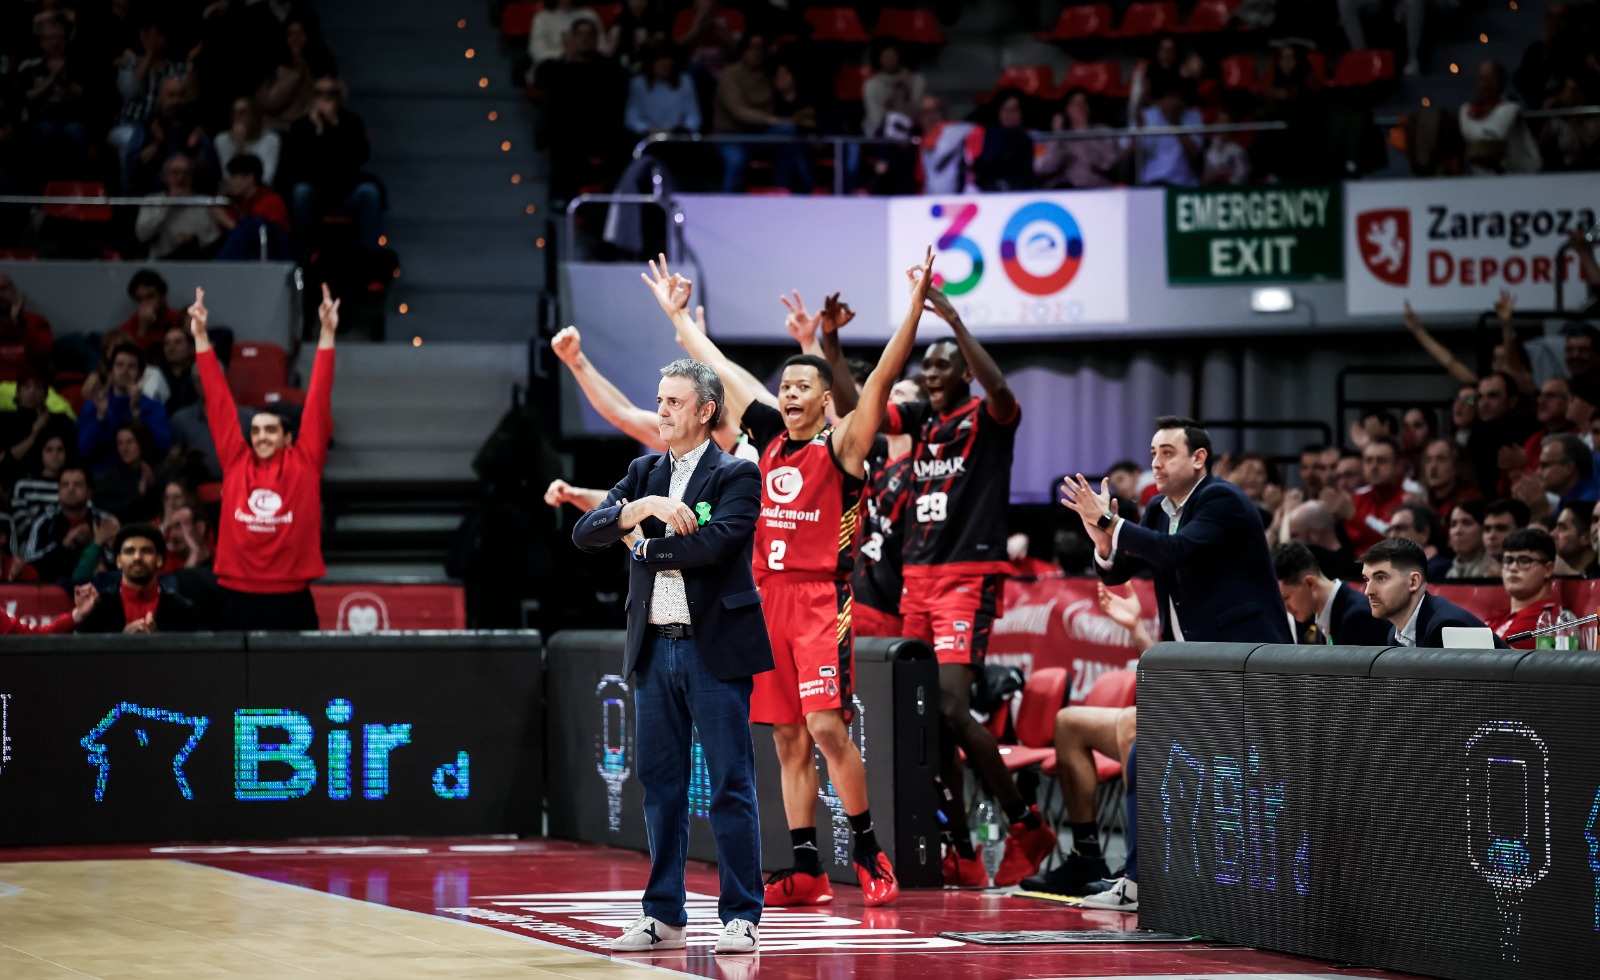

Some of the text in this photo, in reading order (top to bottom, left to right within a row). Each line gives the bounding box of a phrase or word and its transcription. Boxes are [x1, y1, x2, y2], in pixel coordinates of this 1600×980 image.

[1175, 189, 1330, 232] EMERGENCY
[1427, 204, 1597, 249] Zaragoza
[930, 201, 1084, 297] 30
[1210, 236, 1297, 276] EXIT
[916, 492, 948, 522] 29
[768, 539, 787, 571] 2
